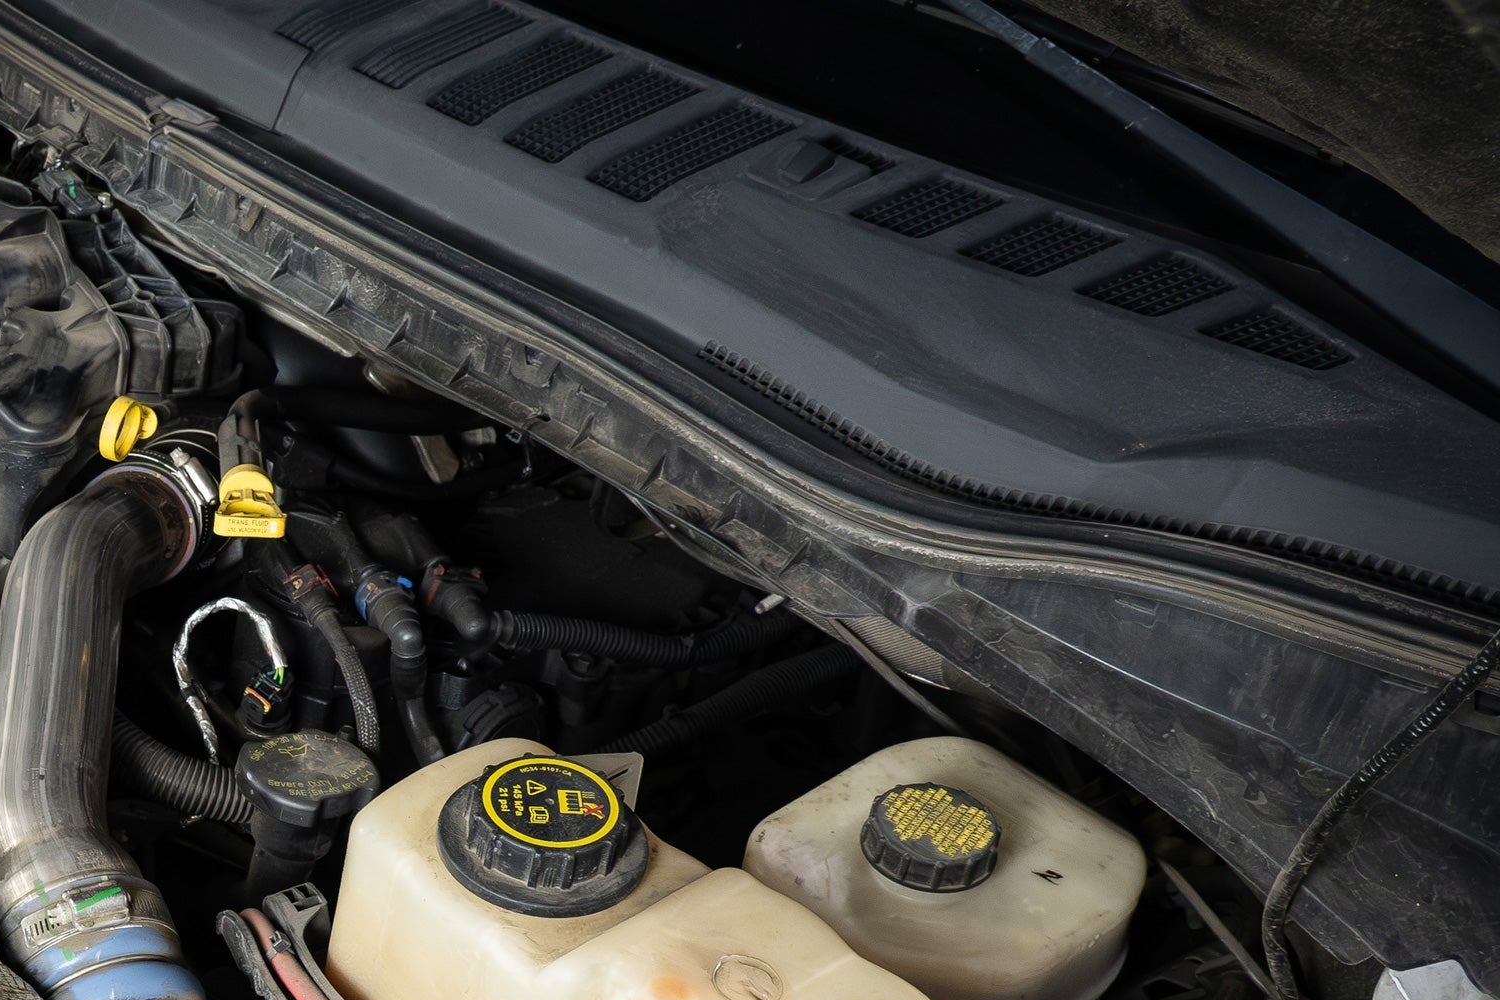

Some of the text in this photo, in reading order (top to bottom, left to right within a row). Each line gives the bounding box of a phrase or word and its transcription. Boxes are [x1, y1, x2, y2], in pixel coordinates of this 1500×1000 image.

[268, 780, 304, 788] Severe
[498, 787, 510, 813] 21 psi
[513, 784, 524, 817] 145 kPa
